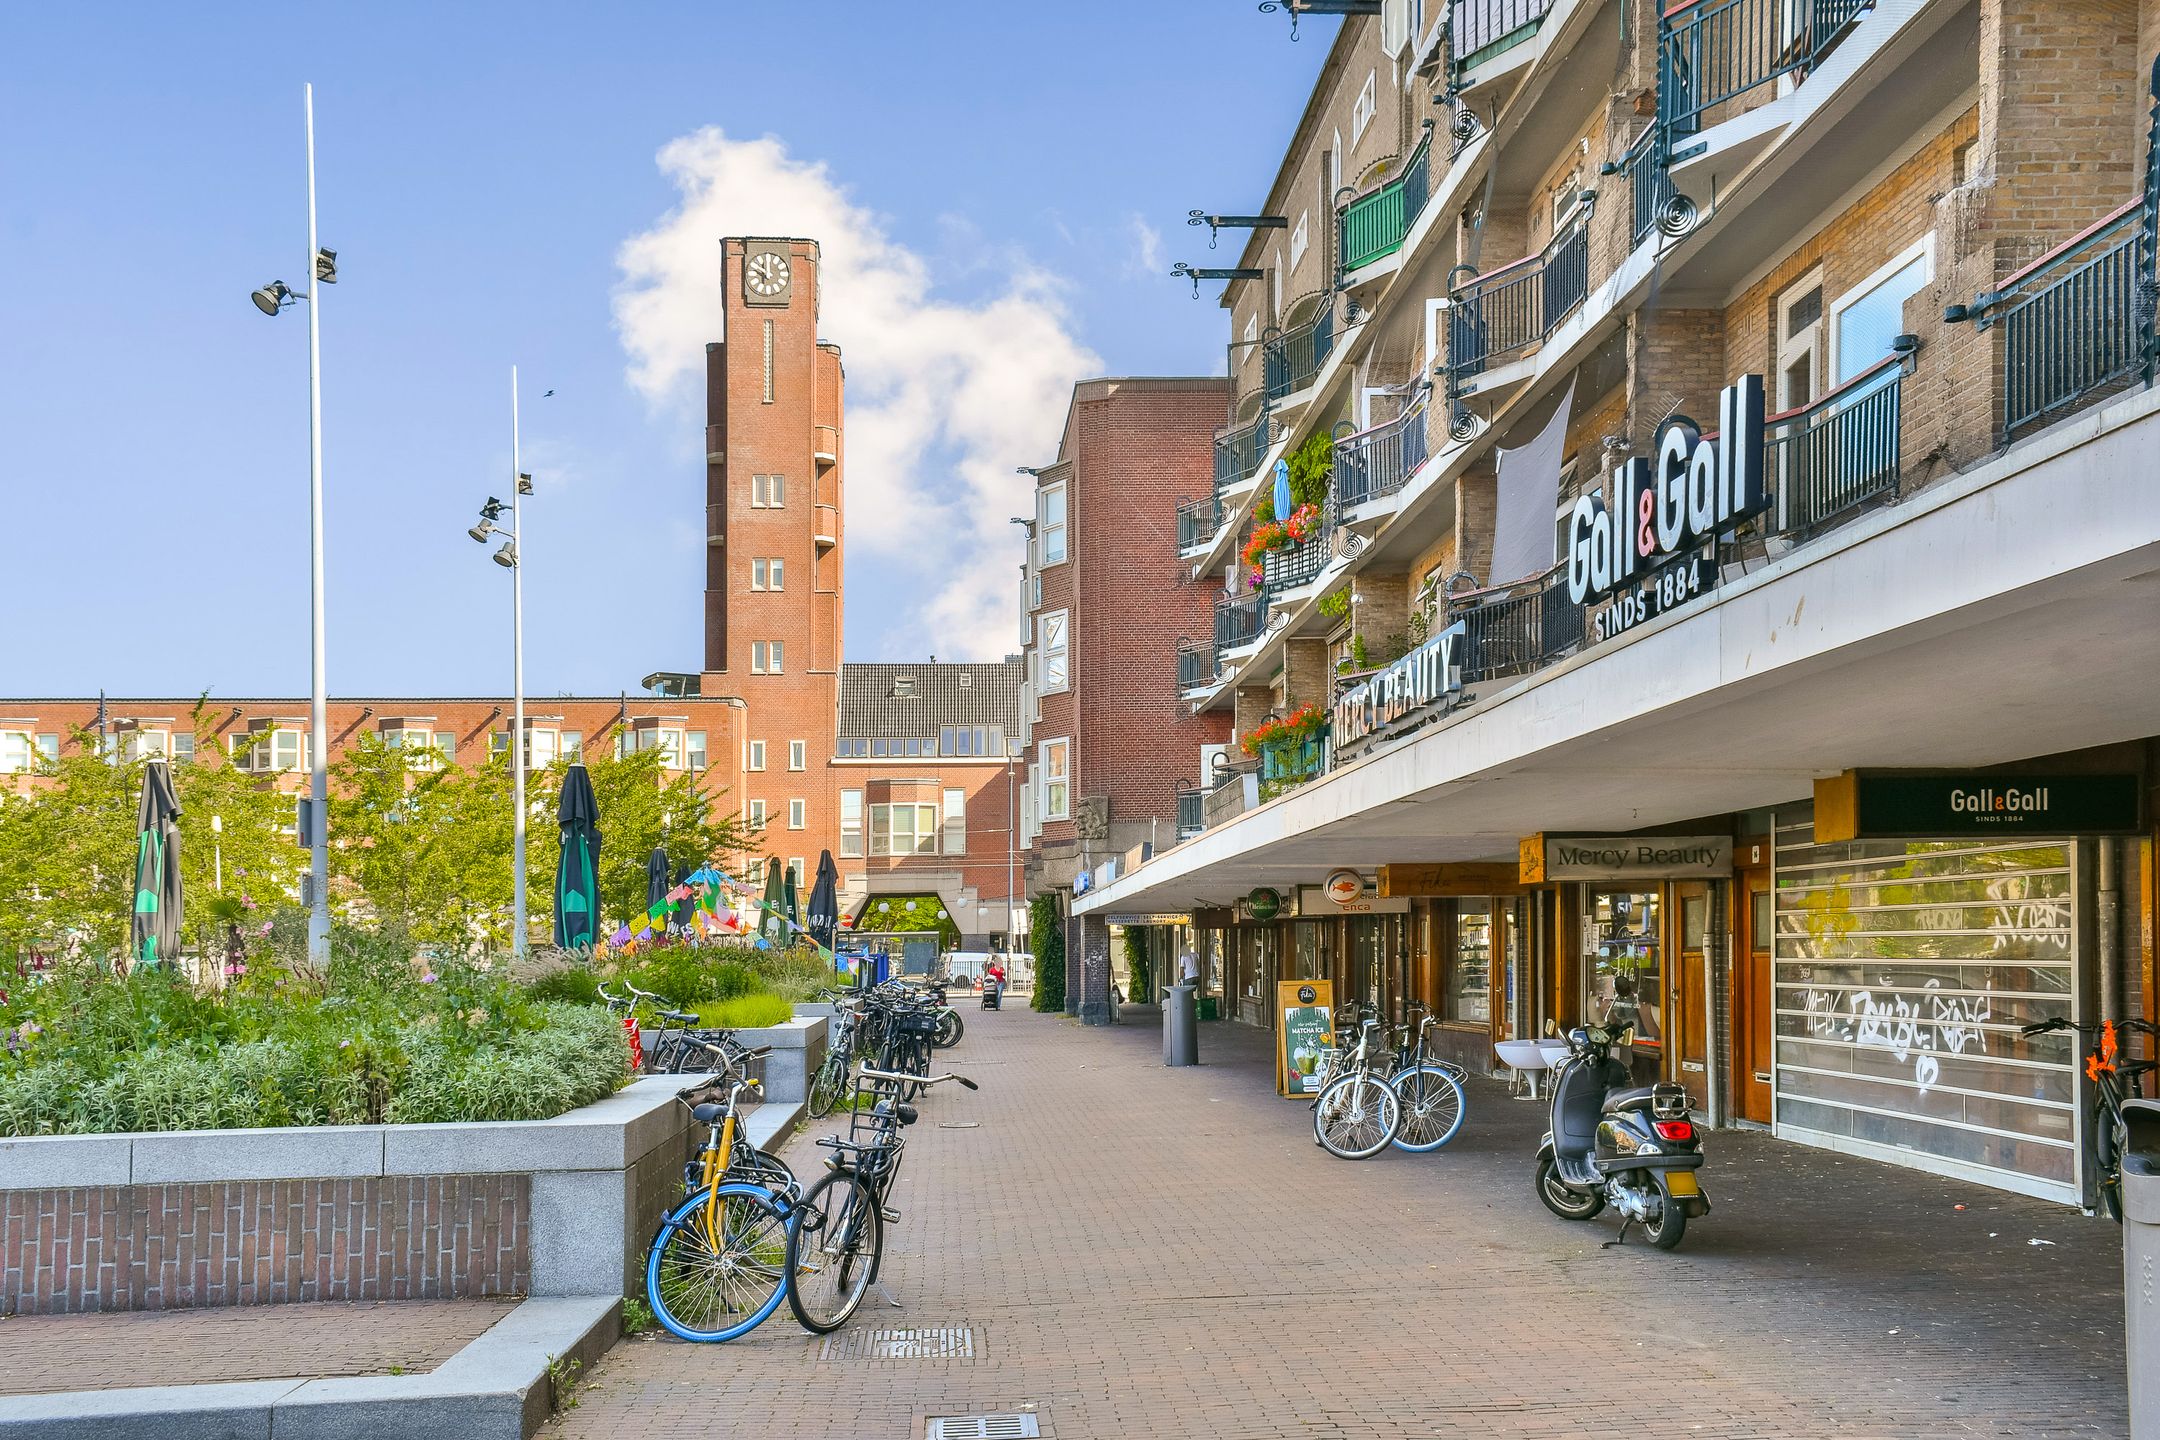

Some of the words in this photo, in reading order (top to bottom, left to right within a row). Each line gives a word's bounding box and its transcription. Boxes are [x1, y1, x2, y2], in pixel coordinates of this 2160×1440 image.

[1595, 591, 1647, 642] SINDS
[1655, 558, 1700, 612] 1884
[1384, 633, 1454, 724] BEAUTY
[1975, 815, 2001, 823] SINDS
[1557, 847, 1630, 869] Mercy
[1636, 846, 1721, 868] Beauty
[1291, 1027, 1315, 1035] MATCHA
